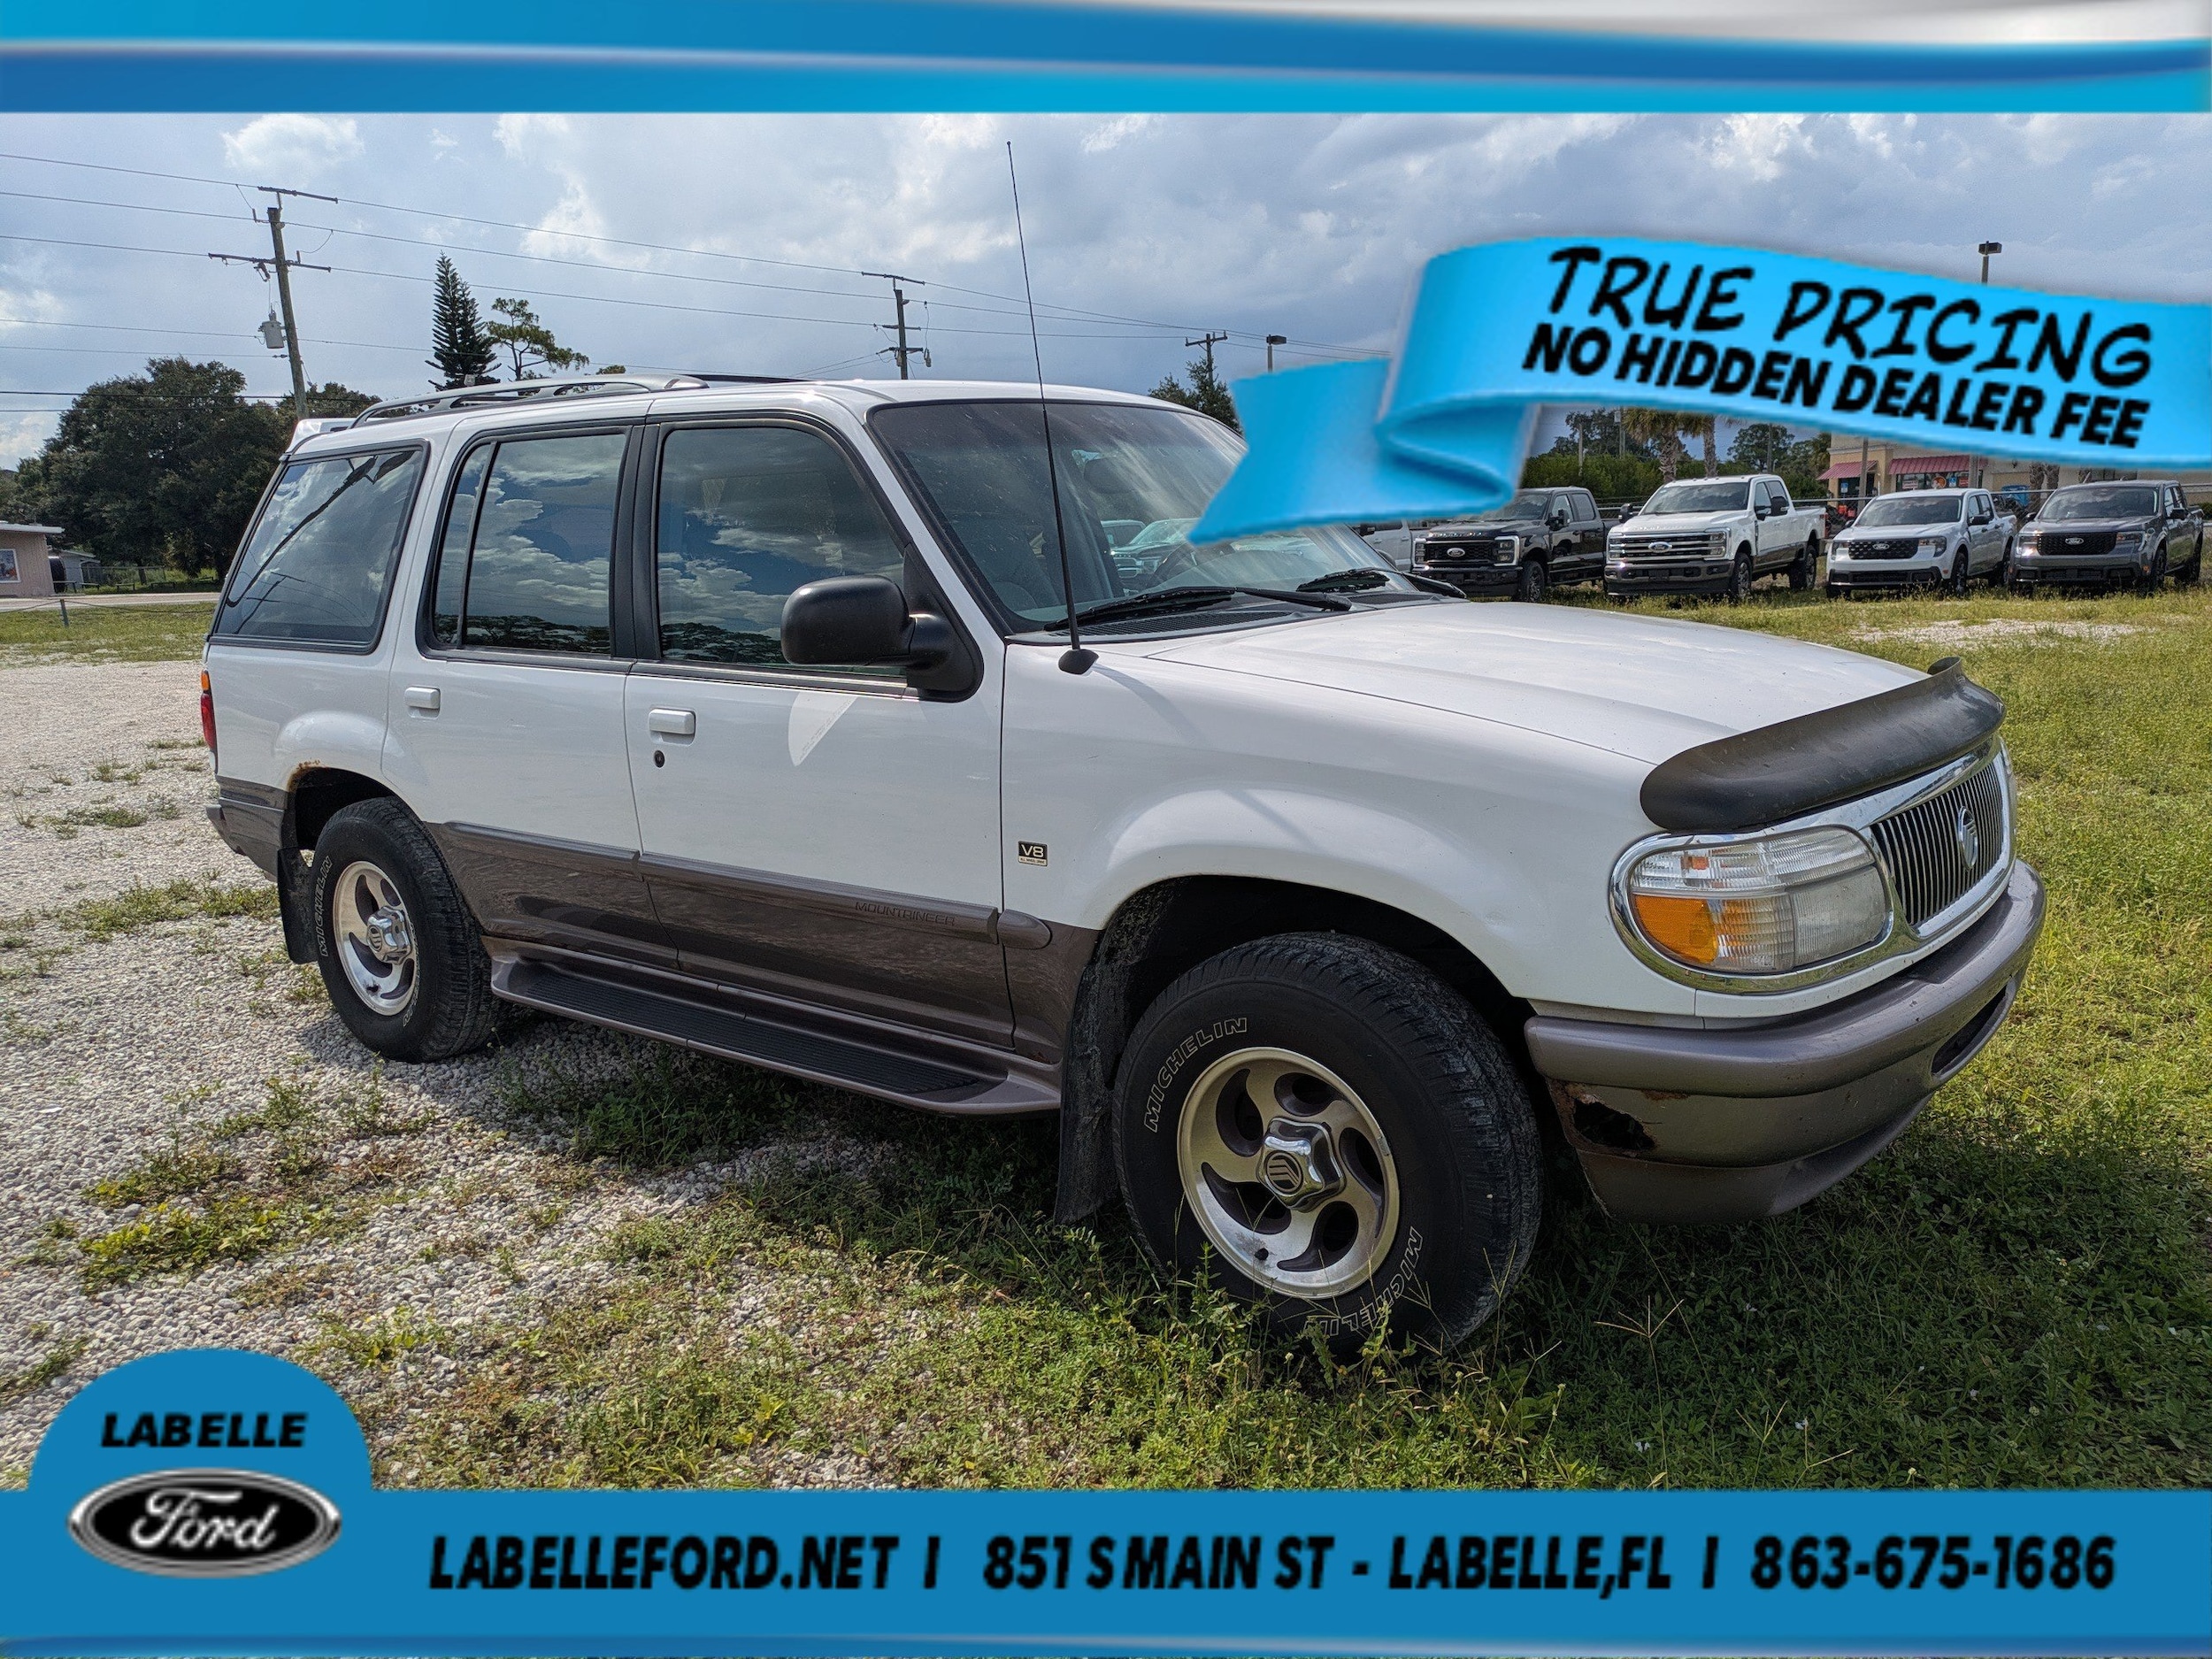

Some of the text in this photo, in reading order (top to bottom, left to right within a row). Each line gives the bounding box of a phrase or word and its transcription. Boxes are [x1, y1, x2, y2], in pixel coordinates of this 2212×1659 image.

[1021, 844, 1044, 858] V8
[314, 855, 333, 957] MICHELIN
[855, 902, 955, 926] MOUNTAINEER
[1144, 1017, 1248, 1133] MICHELIN
